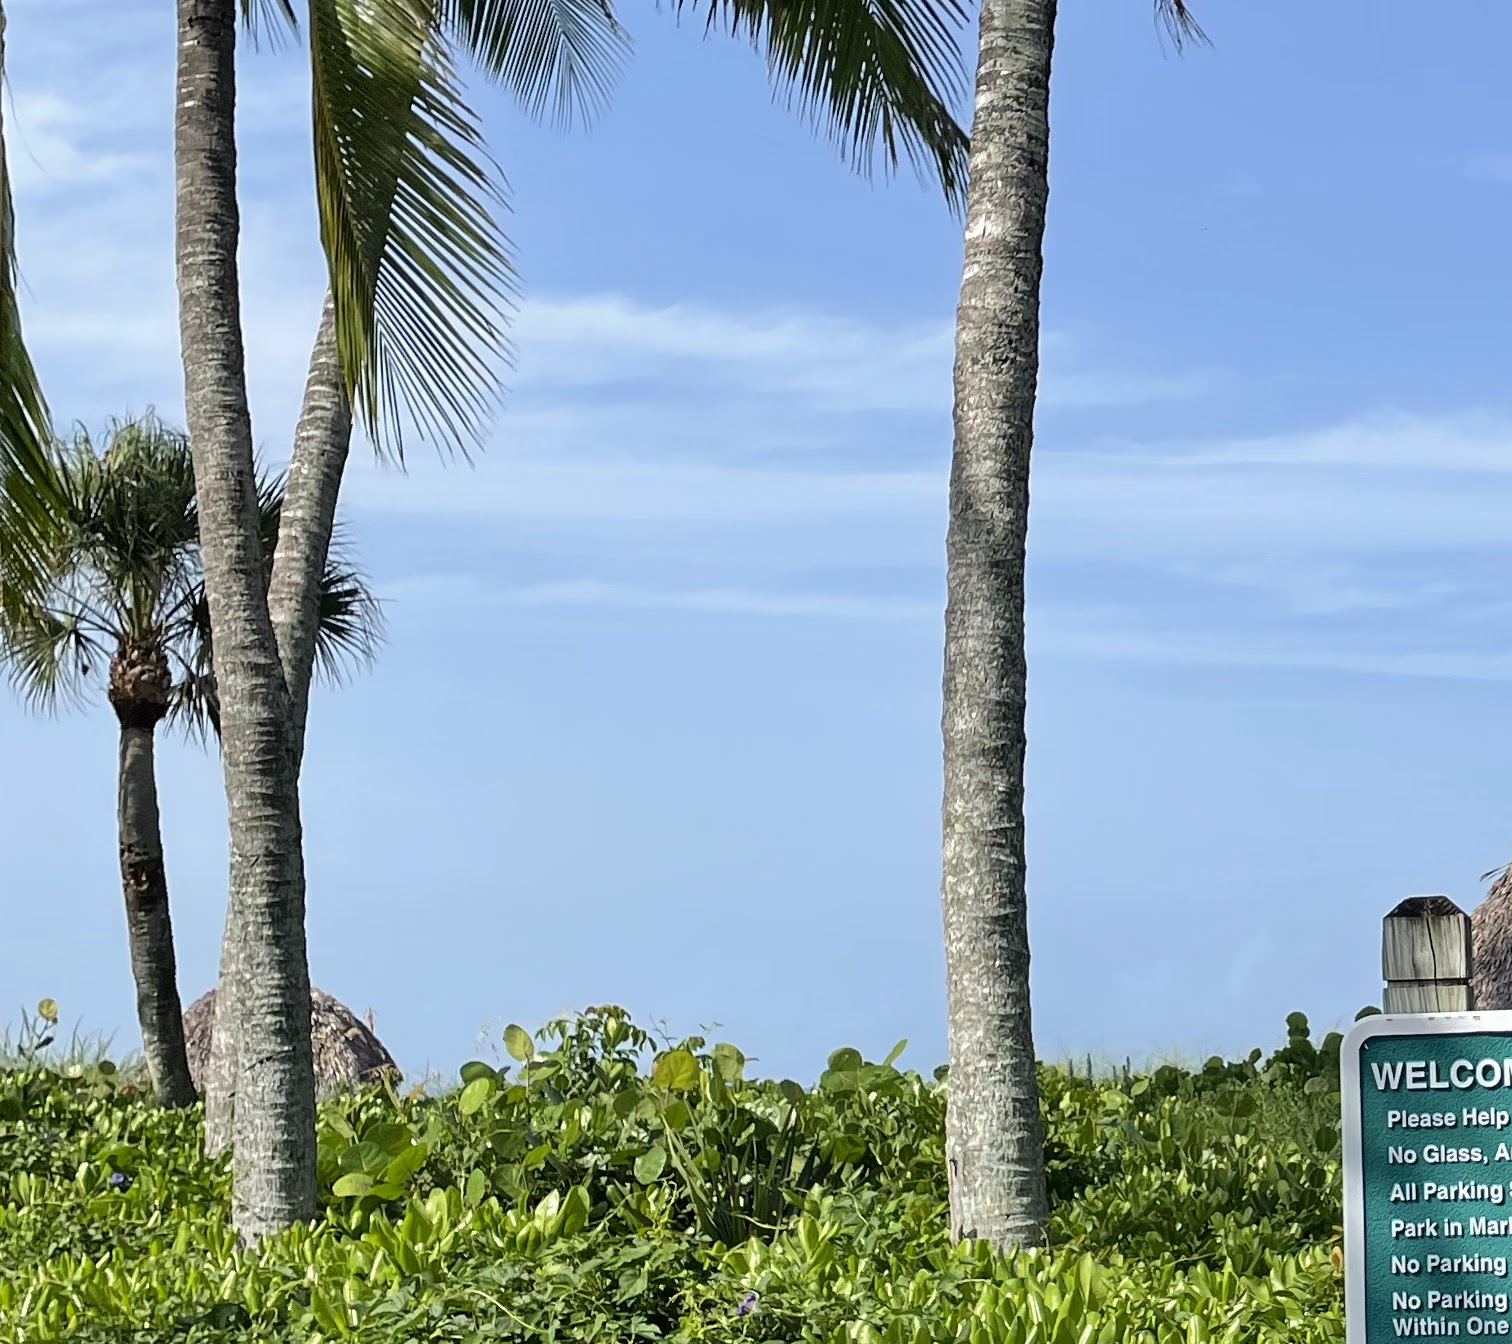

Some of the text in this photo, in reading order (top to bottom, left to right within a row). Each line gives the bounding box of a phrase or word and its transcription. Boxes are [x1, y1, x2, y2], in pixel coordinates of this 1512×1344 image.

[1387, 1109, 1457, 1128] Please
[1461, 1106, 1510, 1130] Help
[1388, 1145, 1417, 1164] No
[1422, 1143, 1489, 1165] Glass,
[1389, 1182, 1417, 1202] All
[1423, 1180, 1504, 1204] Parking
[1391, 1217, 1438, 1238] Park
[1443, 1217, 1463, 1237] in
[1391, 1254, 1421, 1274] No
[1426, 1252, 1507, 1277] Parking
[1392, 1291, 1422, 1311] No
[1427, 1289, 1508, 1313] Parking
[1392, 1315, 1460, 1337] Within
[1466, 1316, 1510, 1336] One
